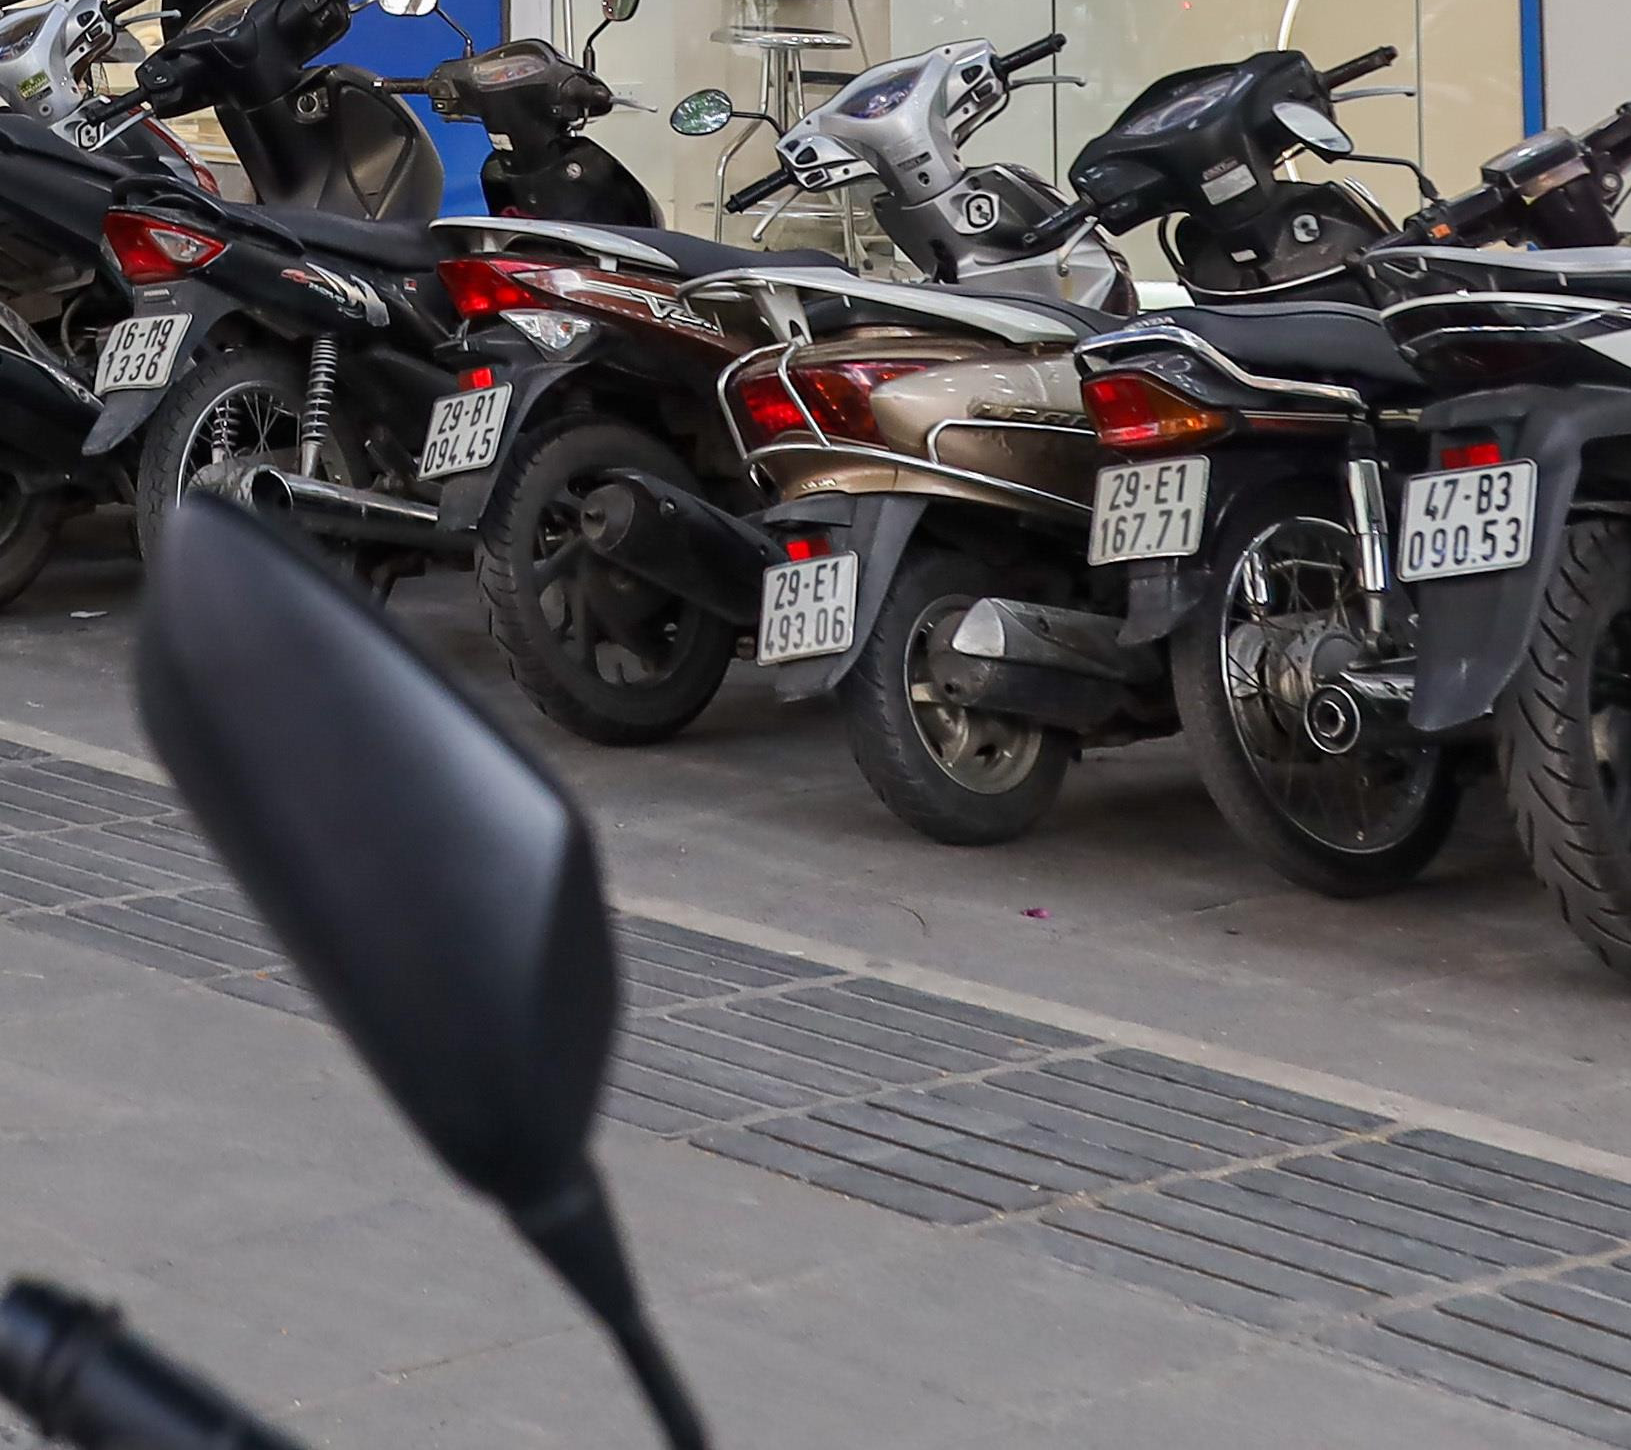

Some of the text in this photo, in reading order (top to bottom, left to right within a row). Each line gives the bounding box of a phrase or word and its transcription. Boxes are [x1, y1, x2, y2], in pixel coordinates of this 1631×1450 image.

[115, 318, 174, 353] 16-M9
[107, 351, 158, 383] 1336
[438, 393, 496, 434] 29-B1
[424, 429, 490, 473] 094.45
[1108, 463, 1189, 510] 29-E1
[1423, 471, 1513, 521] 47-B3
[1100, 508, 1194, 557] 167.71
[1408, 516, 1524, 571] 090.53
[774, 561, 840, 611] 29-E1
[765, 606, 845, 654] 493.06
